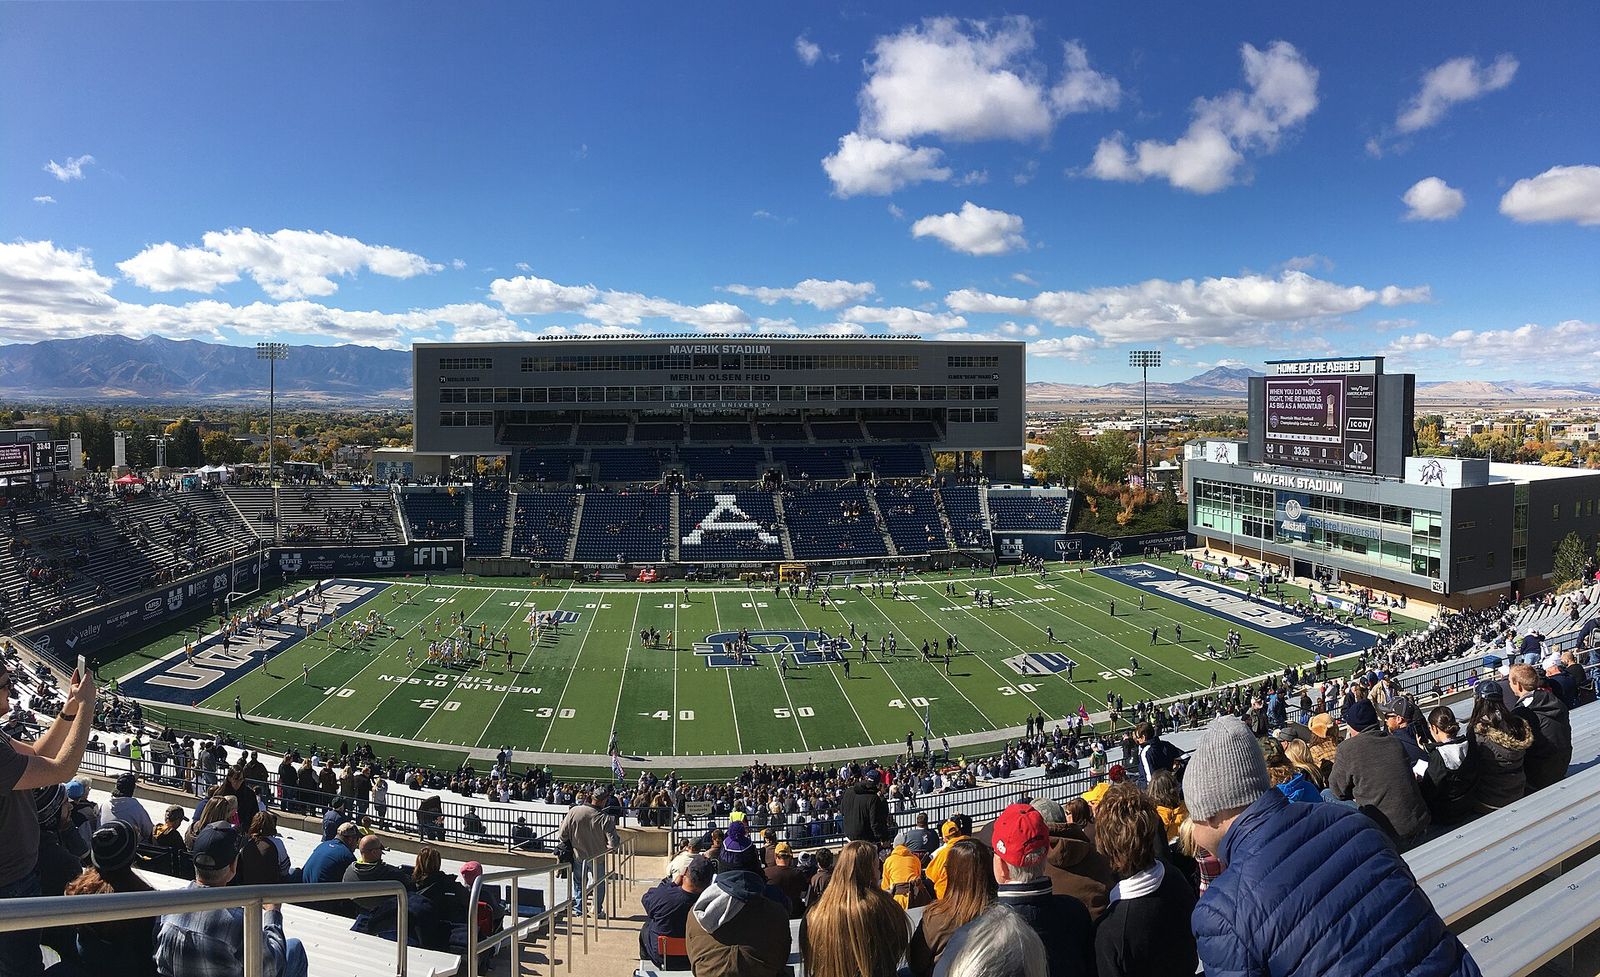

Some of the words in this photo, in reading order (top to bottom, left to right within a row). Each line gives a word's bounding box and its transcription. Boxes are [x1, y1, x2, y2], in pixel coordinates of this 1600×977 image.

[669, 345, 719, 354] MAVERIK
[722, 345, 771, 354] STADIUM
[1277, 362, 1299, 374] HOME
[1299, 363, 1309, 373] OF
[1309, 362, 1327, 373] THE
[1327, 361, 1360, 373] AGGIES
[1253, 472, 1295, 488] MAVERIK
[1296, 477, 1344, 494] STADIUM
[682, 495, 778, 545] A
[1056, 541, 1081, 550] WCF
[279, 558, 303, 566] STATE
[413, 547, 454, 565] iFIT
[167, 593, 184, 605] STATE
[1140, 578, 1306, 629] AGGIES
[79, 623, 101, 638] valley
[377, 673, 449, 688] OLSEN
[434, 673, 494, 684] FIELD
[322, 686, 356, 698] 10
[456, 682, 543, 694] MERLIN
[997, 683, 1038, 696] 30
[418, 699, 462, 711] 20
[888, 697, 931, 709] 40
[535, 707, 577, 719] 30
[652, 710, 695, 721] 40
[773, 706, 815, 718] 50
